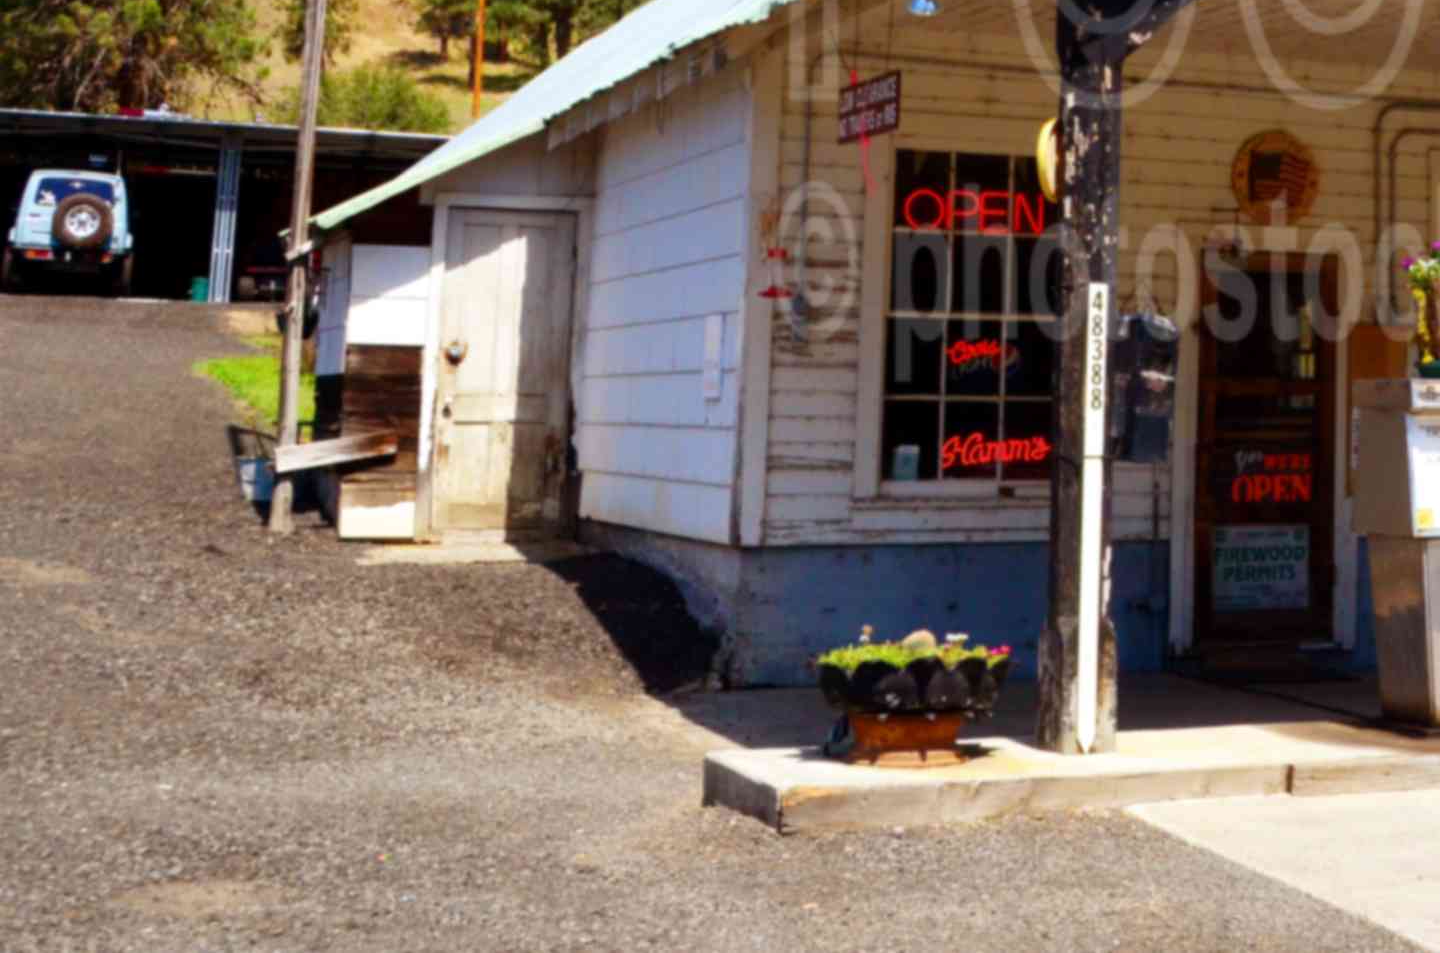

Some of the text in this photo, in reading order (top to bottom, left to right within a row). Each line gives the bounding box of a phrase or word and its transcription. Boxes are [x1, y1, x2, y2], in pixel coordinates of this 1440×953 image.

[903, 188, 1046, 236] OPEN
[1231, 473, 1313, 503] OPEN
[1215, 545, 1306, 566] FIREWOOD
[1223, 565, 1297, 582] PERMITS
